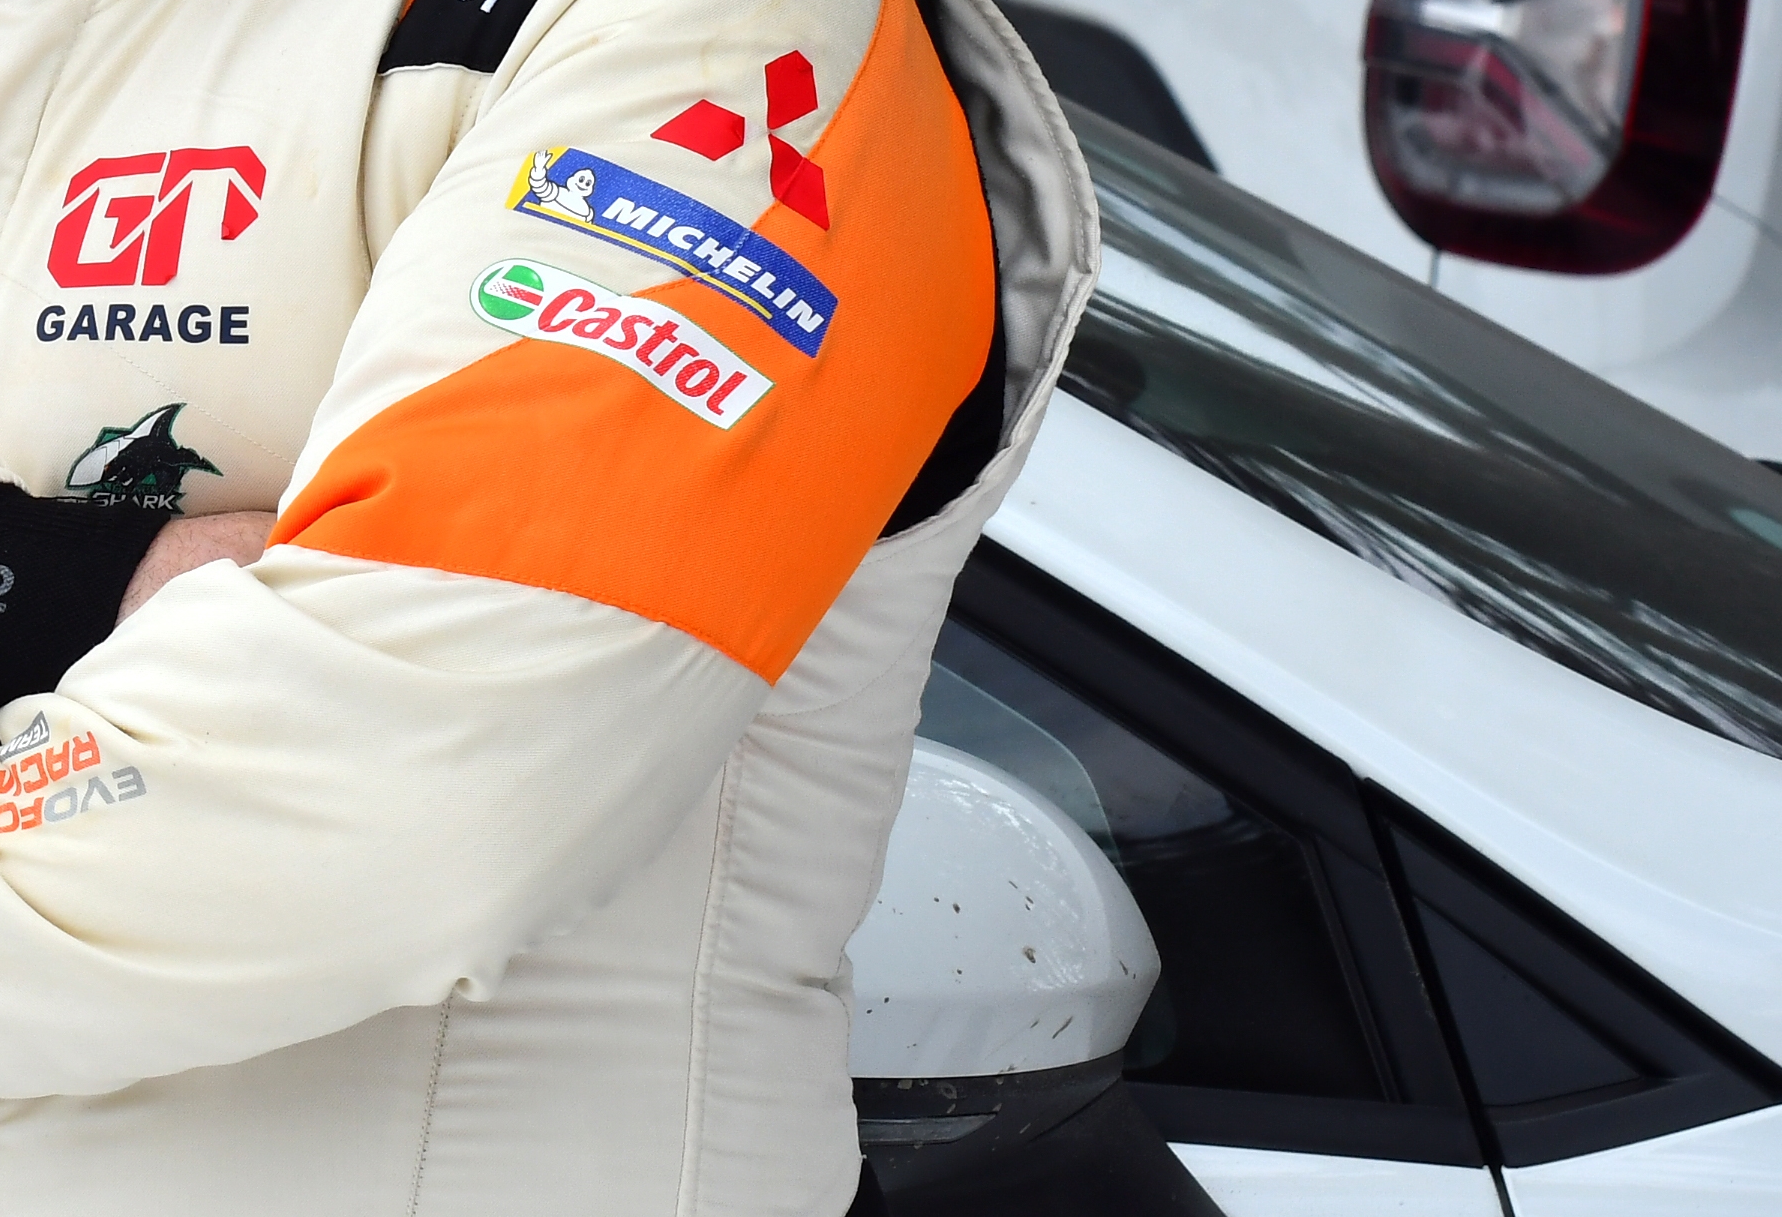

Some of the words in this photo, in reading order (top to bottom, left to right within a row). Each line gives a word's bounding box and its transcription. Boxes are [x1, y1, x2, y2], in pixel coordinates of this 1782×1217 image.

[47, 146, 267, 289] GT
[602, 196, 825, 334] MICHELIN
[36, 303, 250, 345] GARAGE
[536, 287, 748, 416] Castrol
